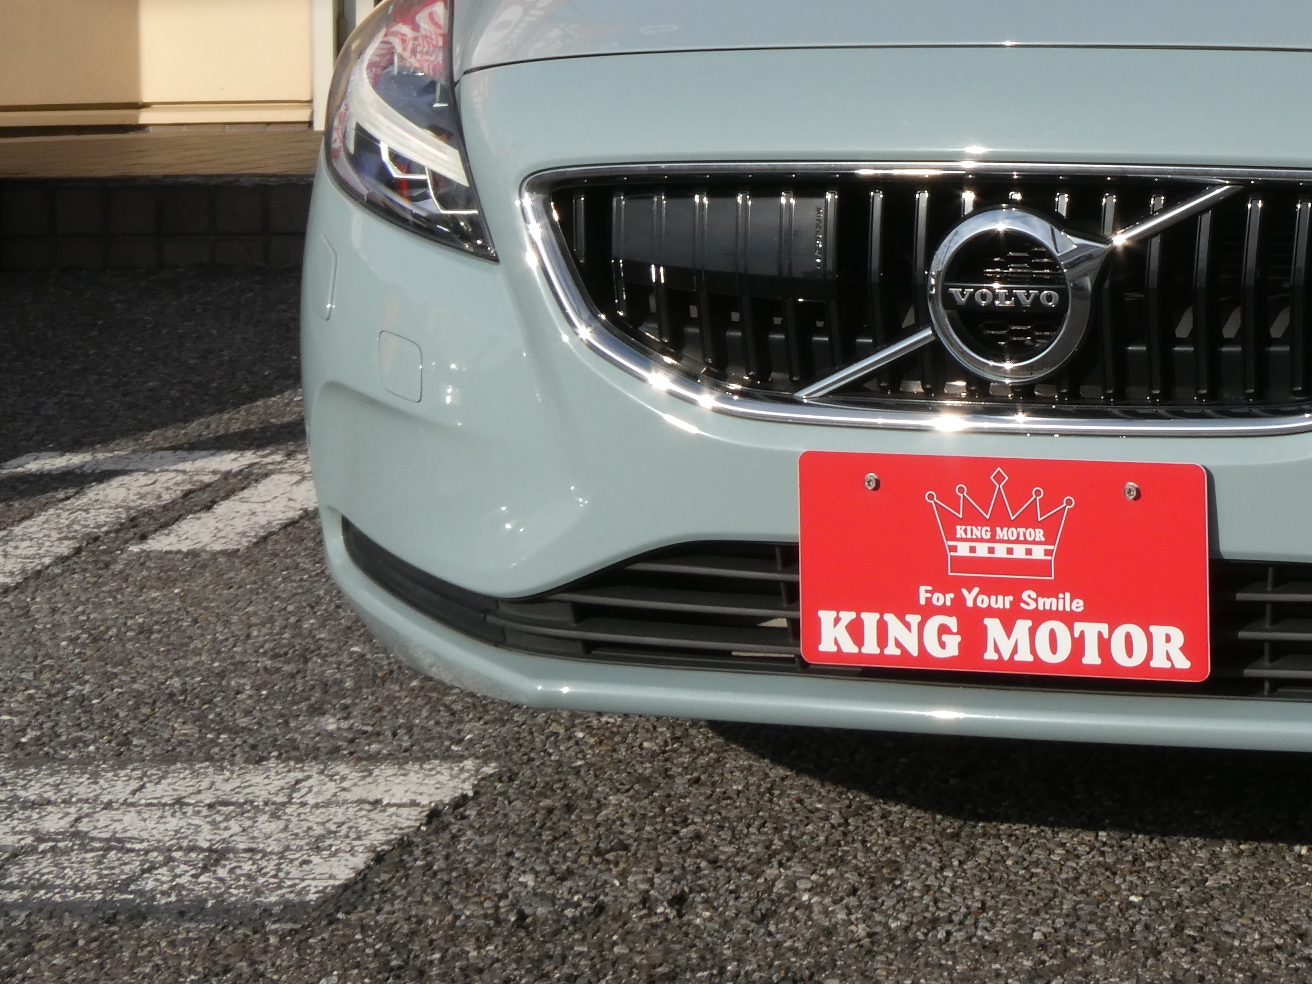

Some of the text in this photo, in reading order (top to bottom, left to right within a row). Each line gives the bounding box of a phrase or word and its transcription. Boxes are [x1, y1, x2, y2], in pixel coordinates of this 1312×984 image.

[948, 288, 1060, 308] VOLVO
[955, 524, 1046, 542] KING MOTOR
[919, 585, 1085, 613] For Your Smile
[817, 609, 1192, 670] KING MOTOR
